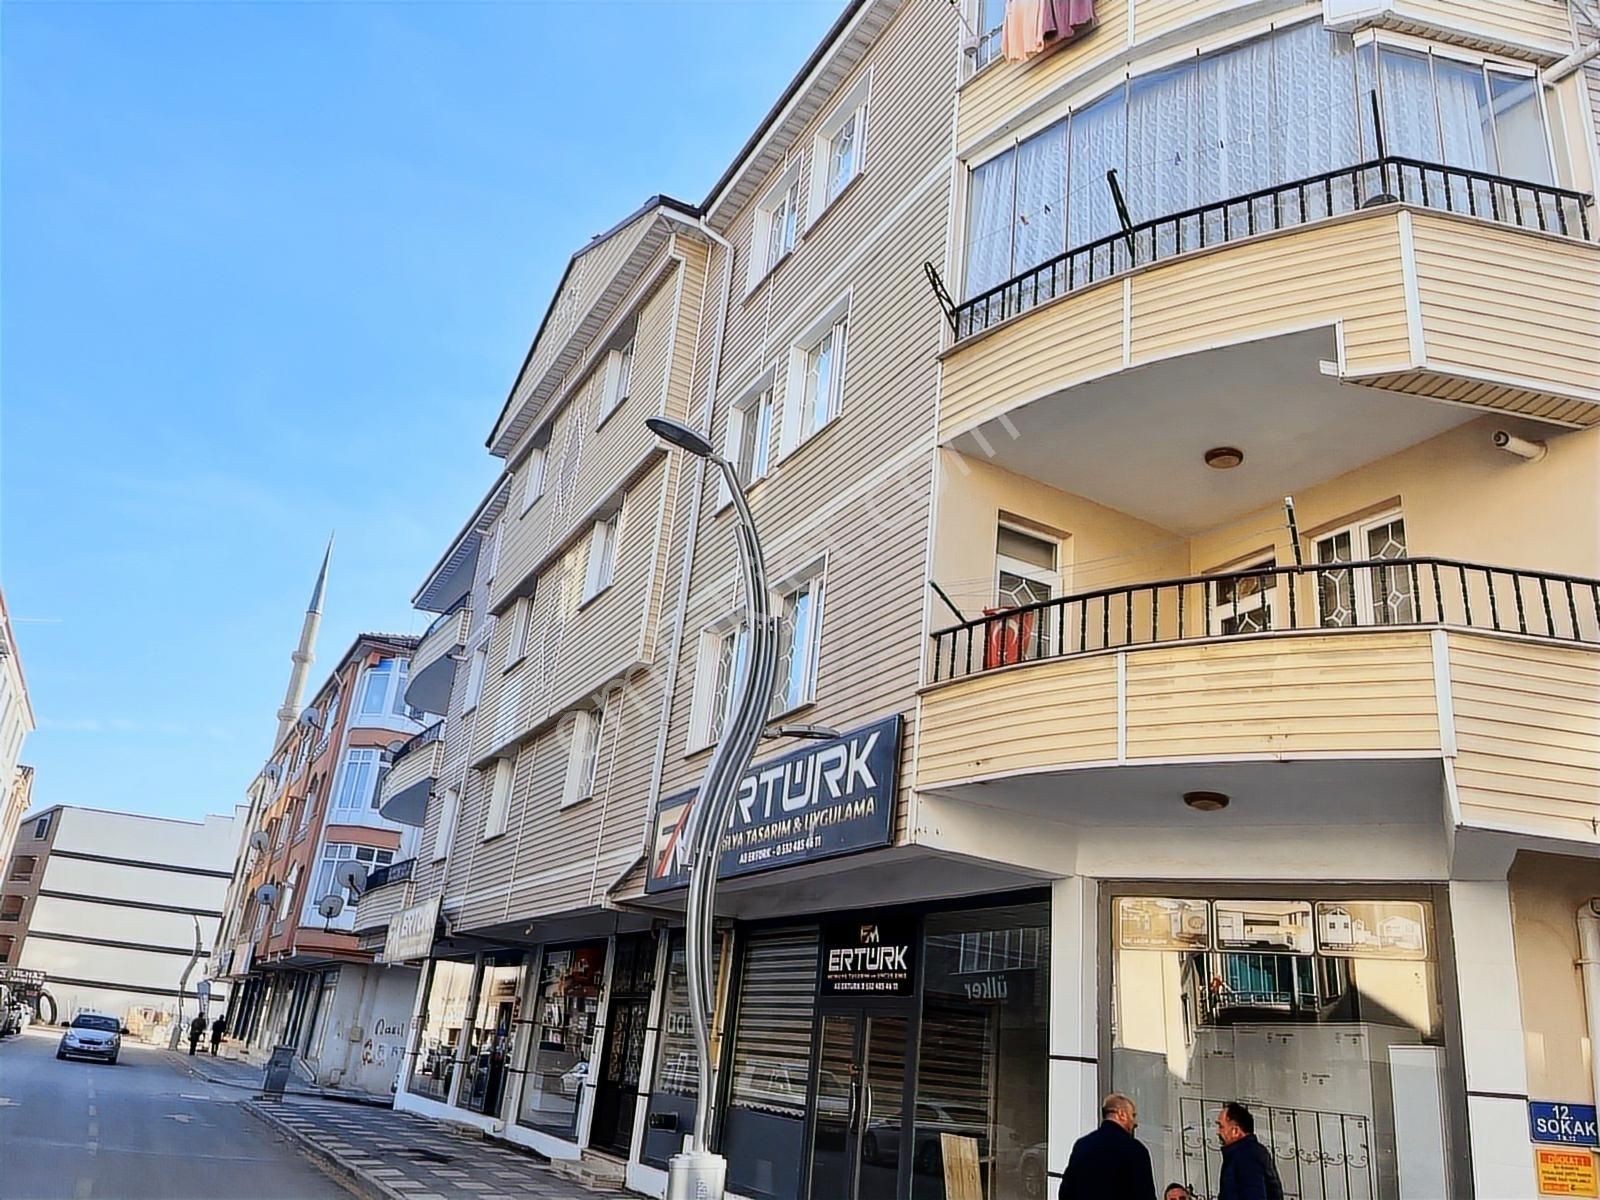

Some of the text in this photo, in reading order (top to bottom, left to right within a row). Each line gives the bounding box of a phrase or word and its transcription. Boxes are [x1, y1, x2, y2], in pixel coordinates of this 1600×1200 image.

[728, 731, 881, 828] RTÜRK
[746, 819, 791, 846] TASARIM
[793, 816, 801, 833] &
[804, 796, 875, 831] UYGULAMA
[828, 946, 908, 972] ERTÜRK
[1537, 1118, 1597, 1136] SOKAK
